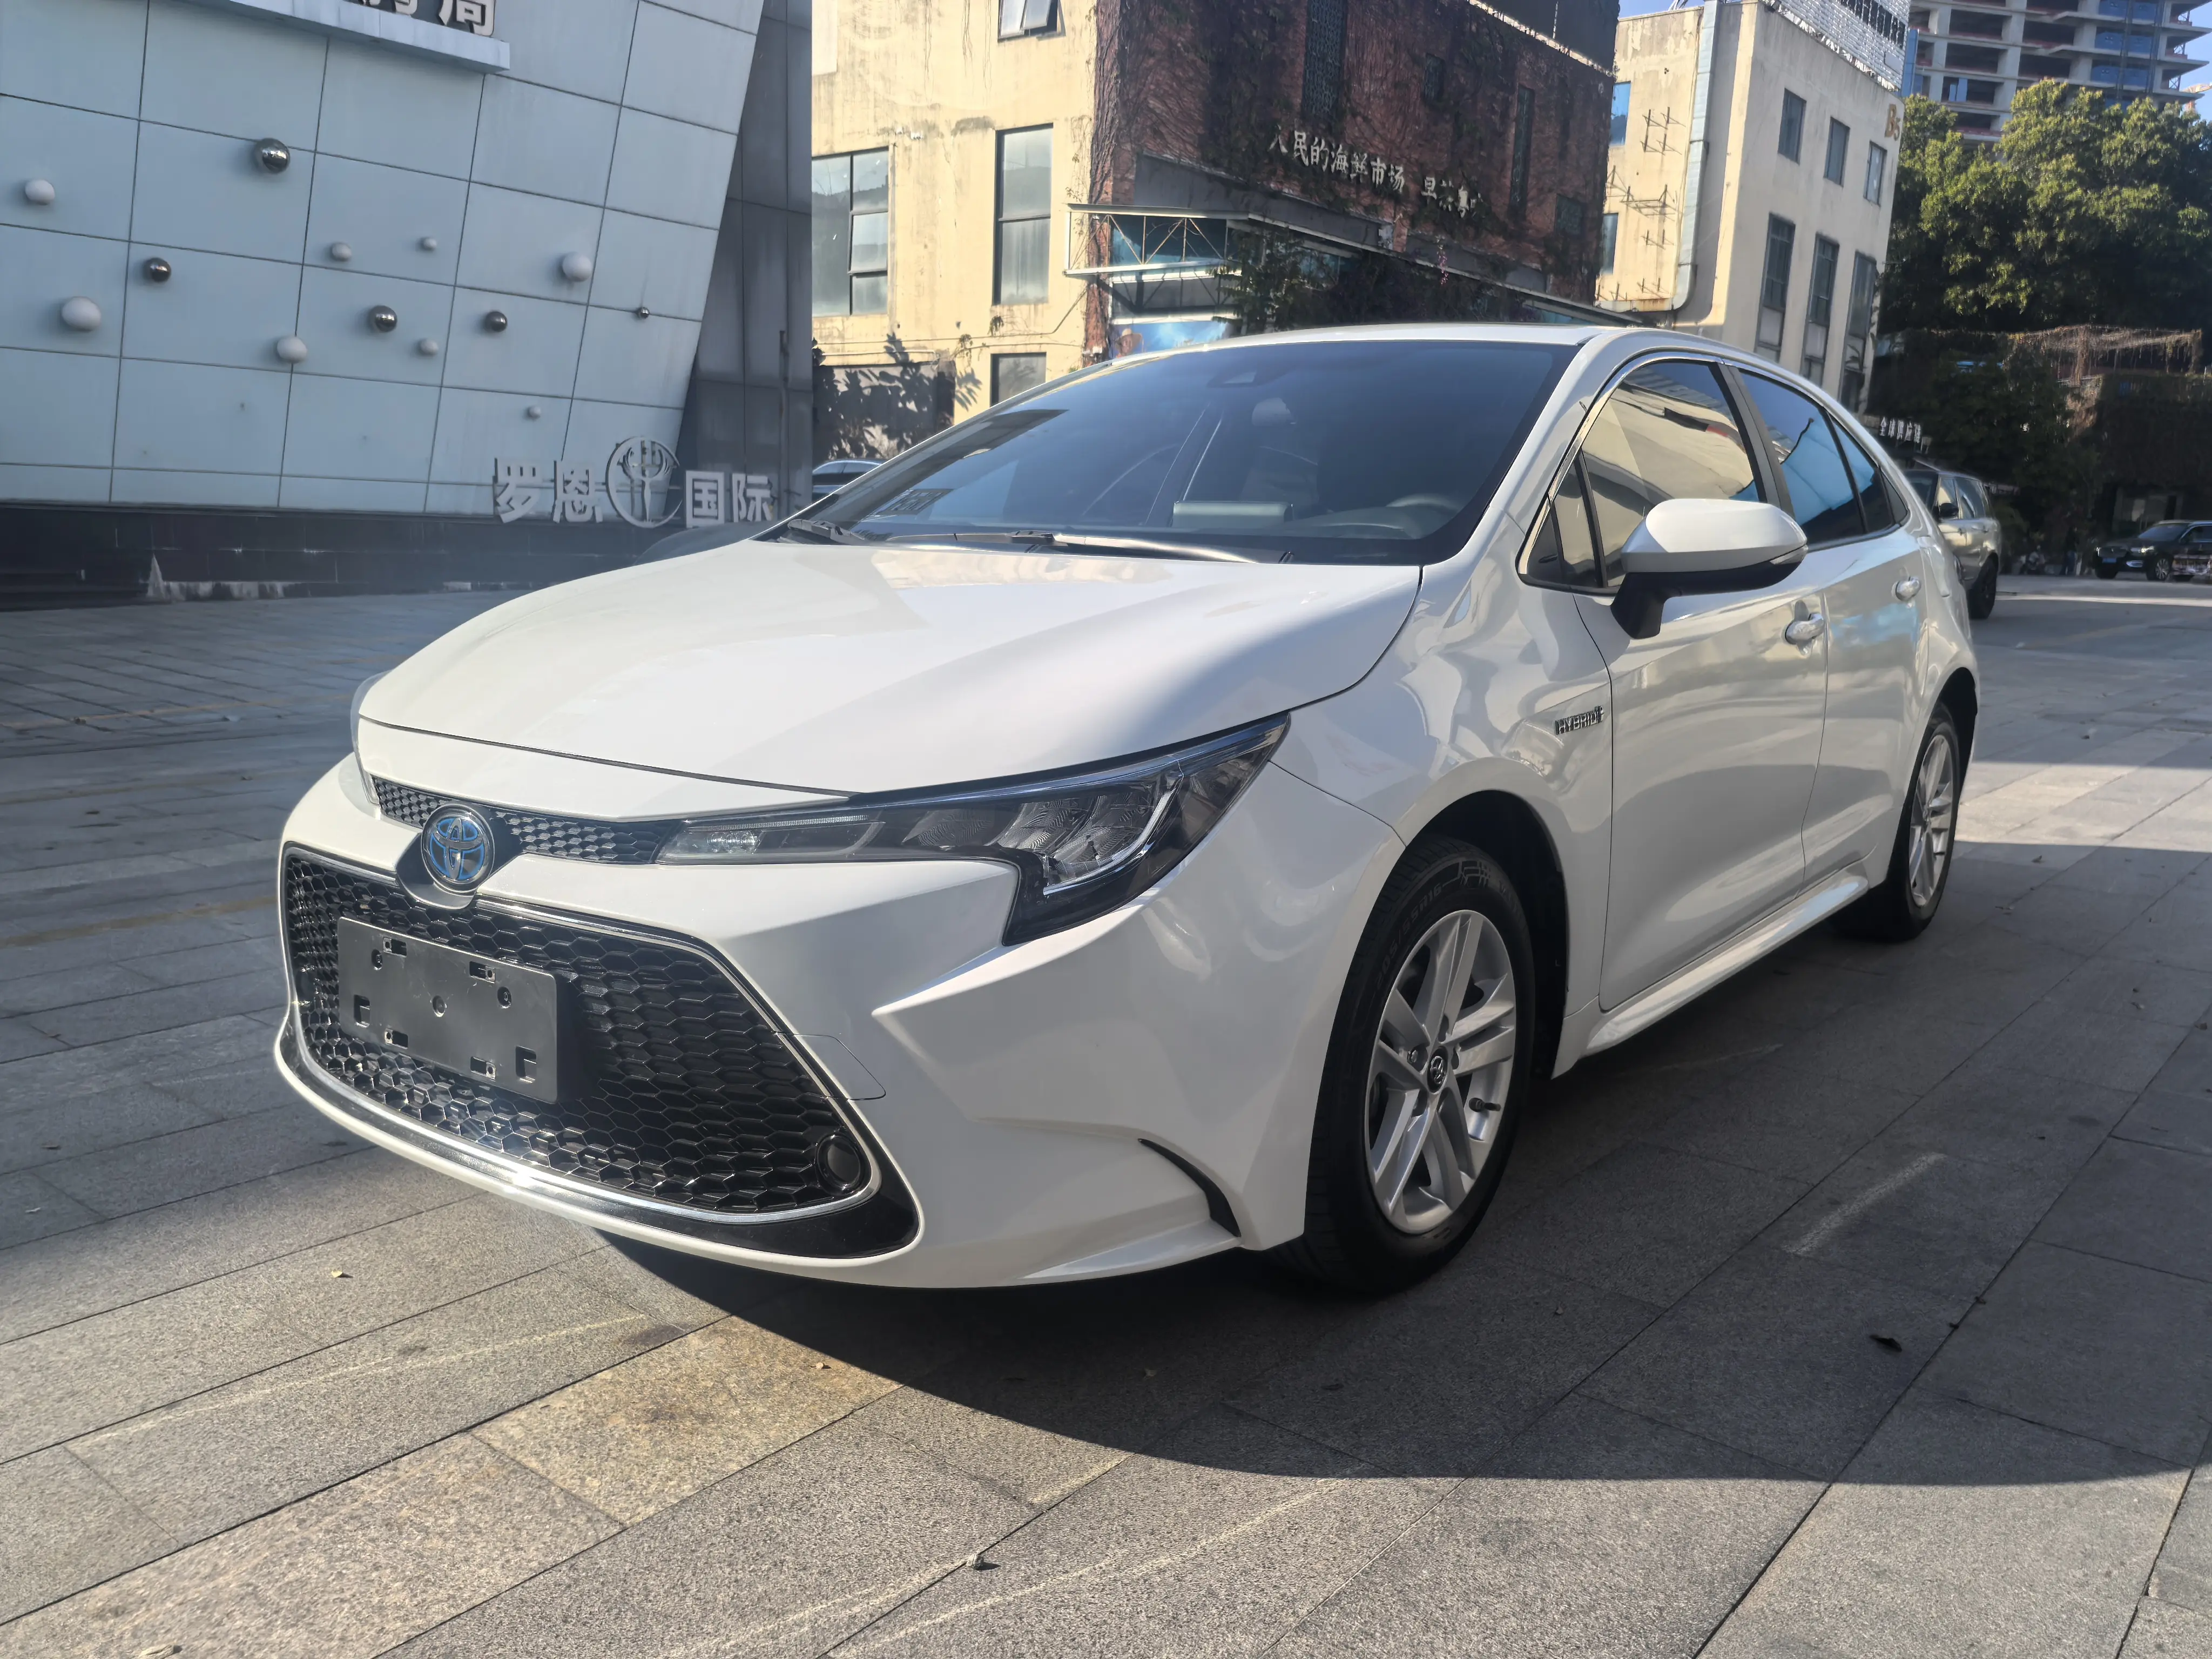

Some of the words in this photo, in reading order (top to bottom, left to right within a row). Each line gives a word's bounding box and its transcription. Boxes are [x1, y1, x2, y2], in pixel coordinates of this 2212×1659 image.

[1269, 124, 1405, 193] 人民的海鲜市场
[494, 458, 603, 524] 罗恩
[685, 470, 774, 528] 国际
[1555, 710, 1599, 736] HYBRID
